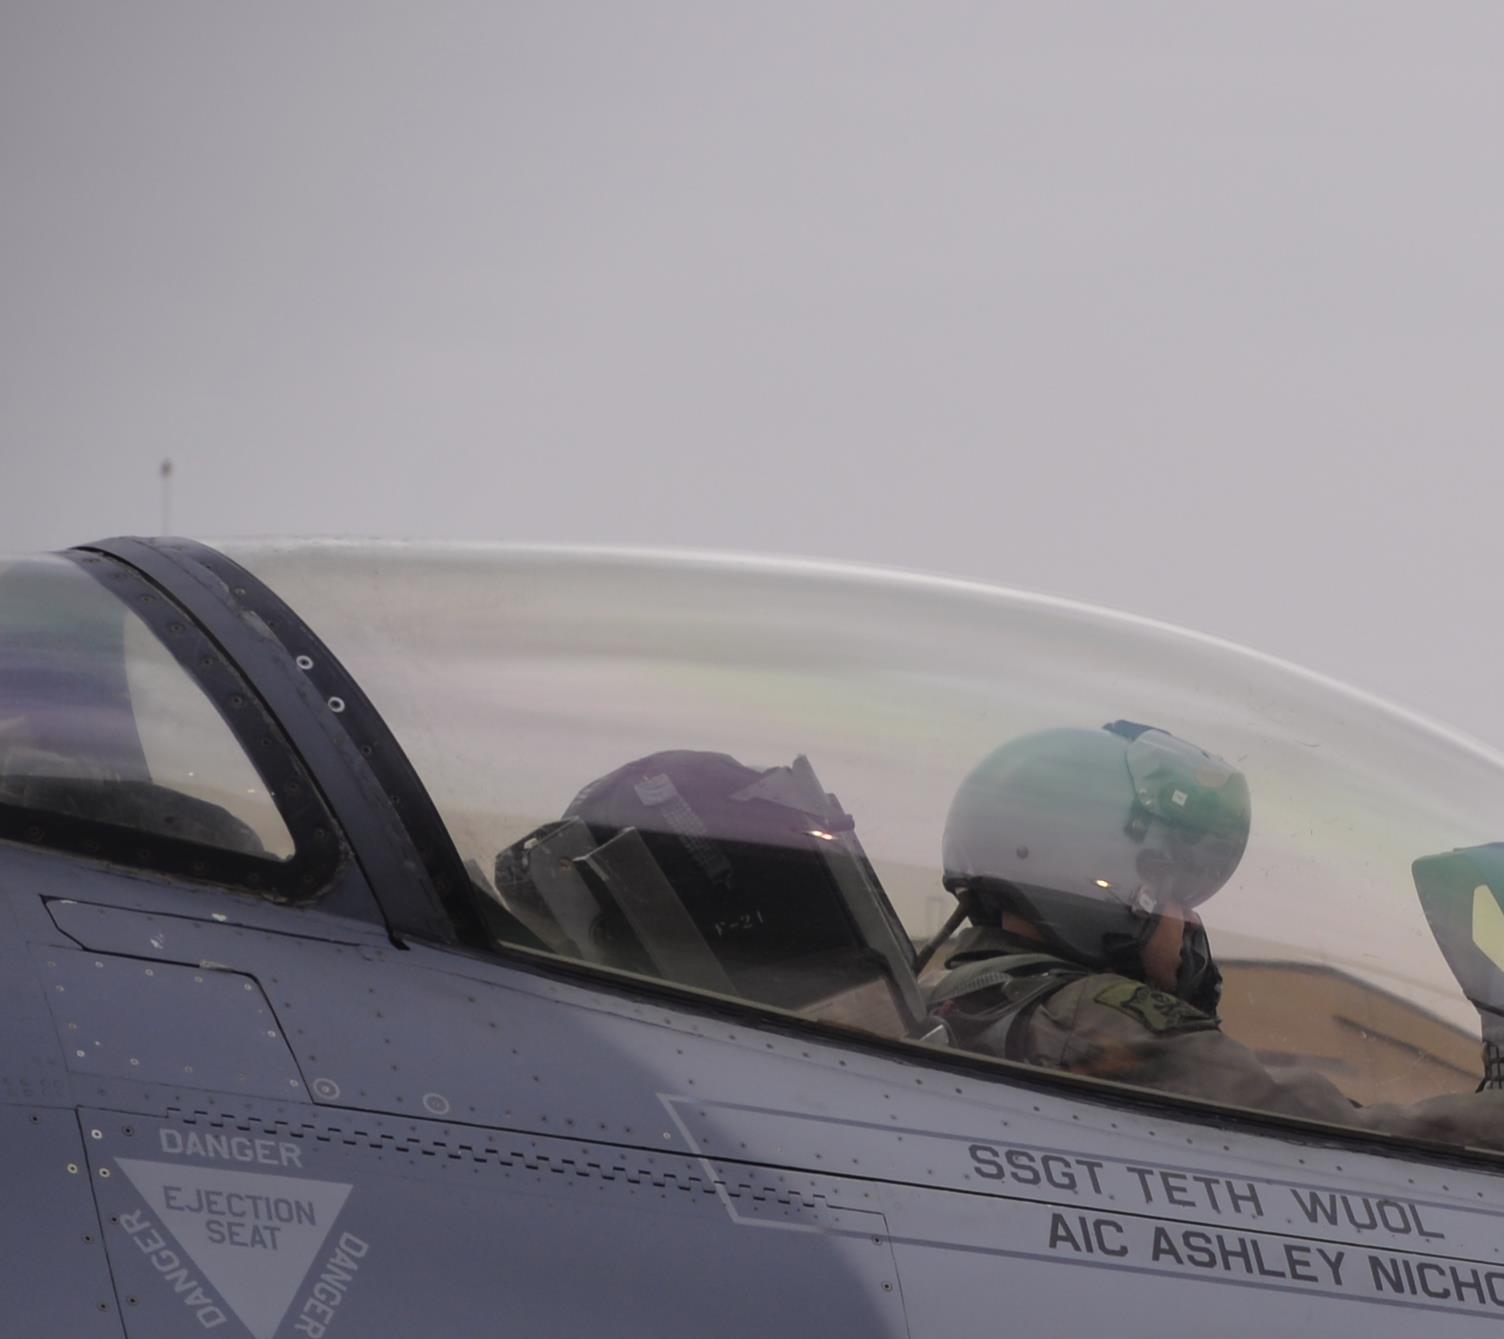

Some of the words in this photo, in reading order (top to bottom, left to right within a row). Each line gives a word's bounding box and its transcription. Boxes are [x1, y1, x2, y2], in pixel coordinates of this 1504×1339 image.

[159, 1128, 304, 1168] DANGER
[163, 1185, 317, 1227] EJECTION
[967, 1142, 1106, 1196] SSGT
[1126, 1165, 1264, 1218] TETH
[1288, 1187, 1446, 1242] WUOL
[205, 1219, 281, 1251] SEAT
[1150, 1226, 1347, 1288] ASHLEY
[119, 1209, 228, 1329] DANGER
[294, 1231, 370, 1339] DANGER
